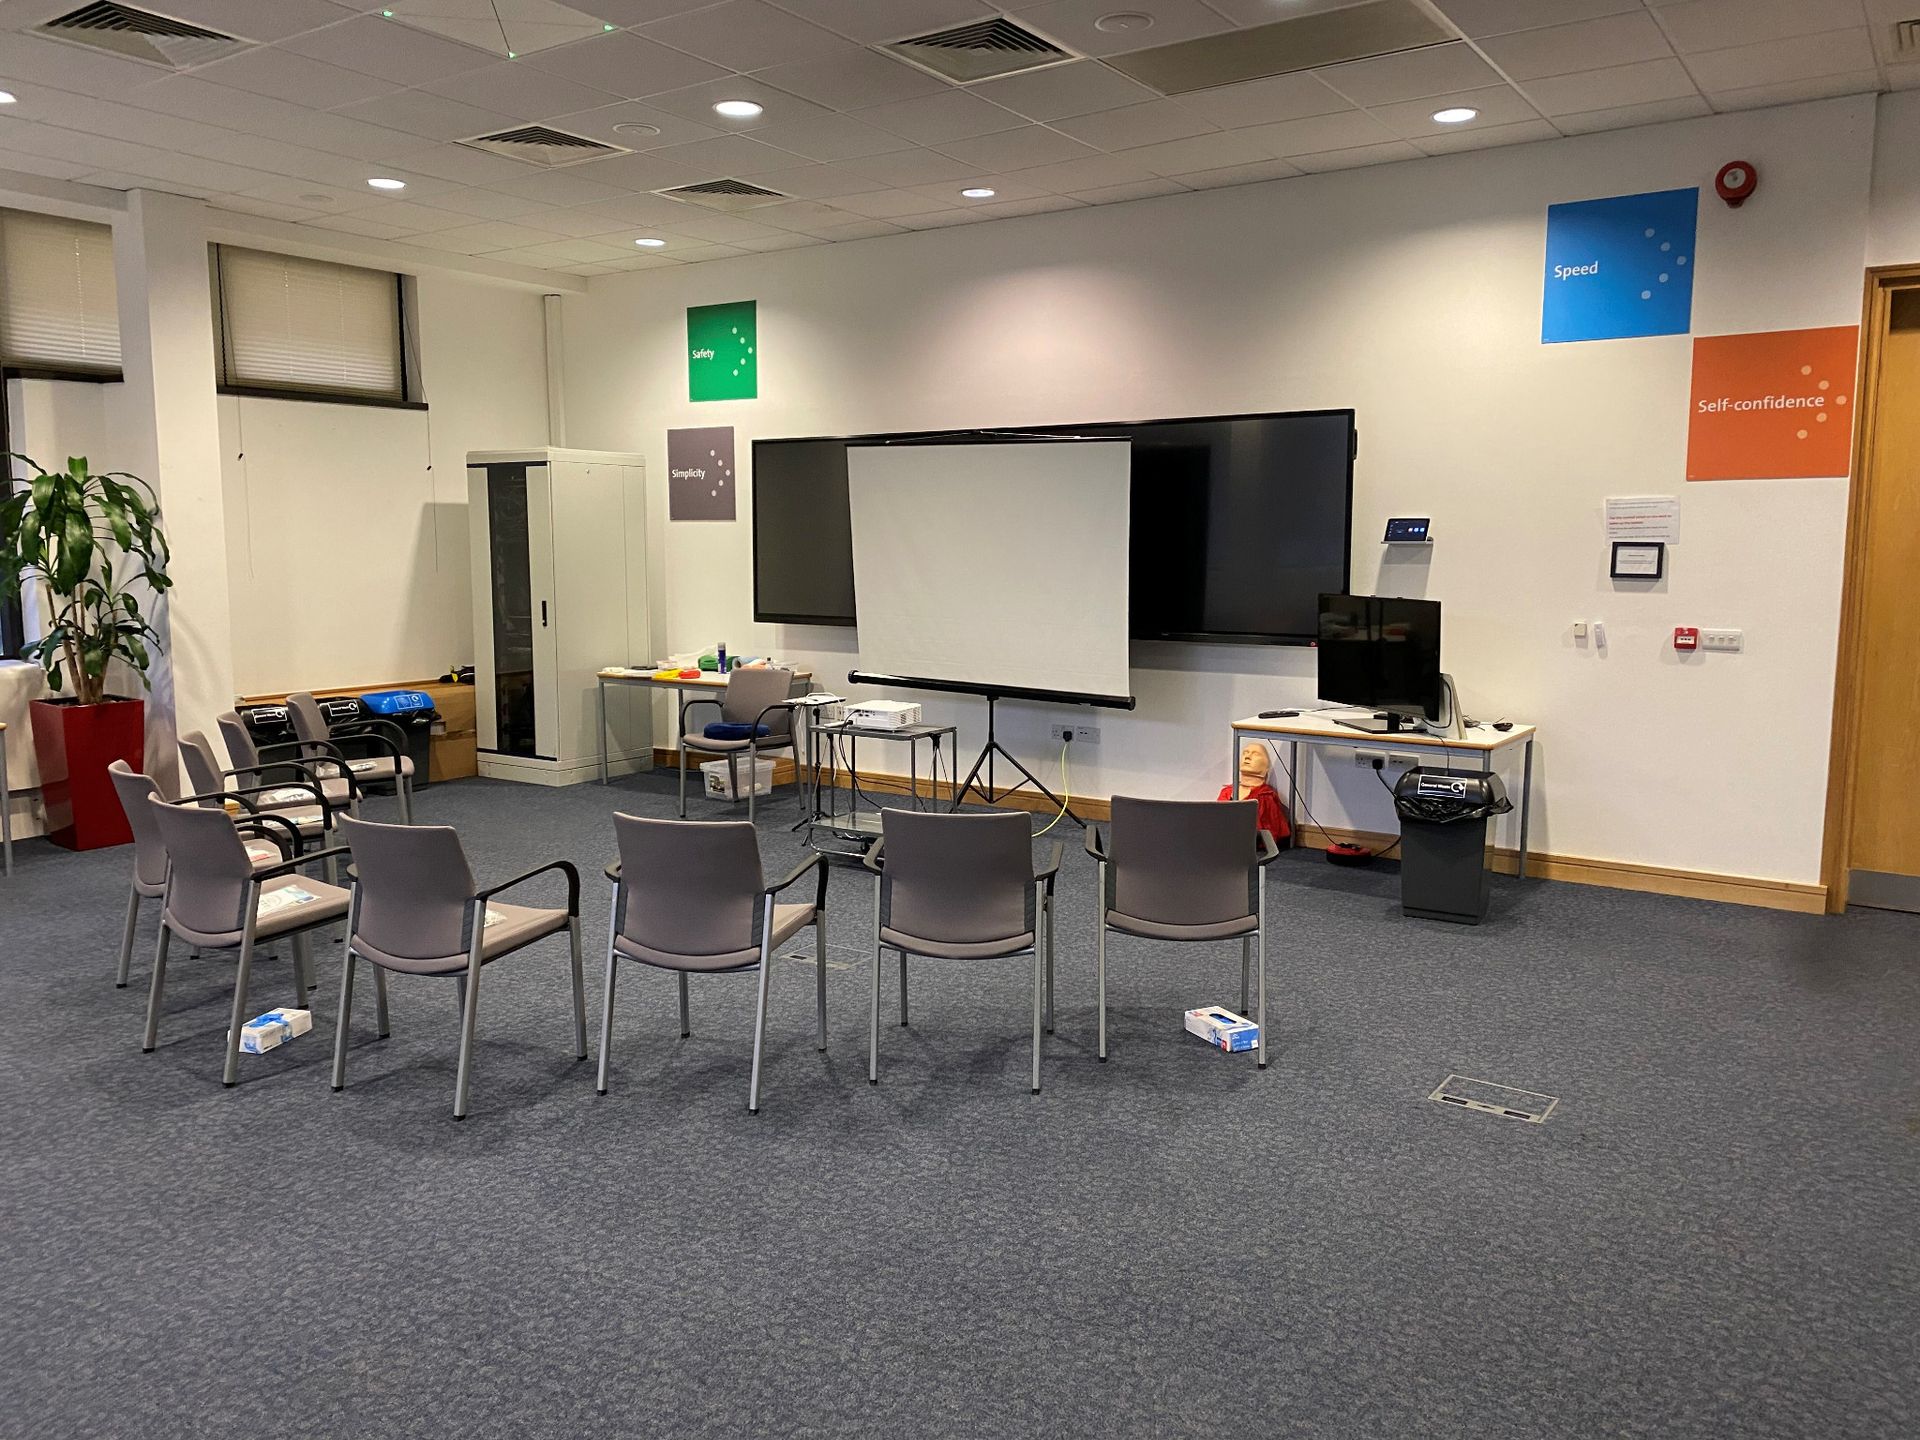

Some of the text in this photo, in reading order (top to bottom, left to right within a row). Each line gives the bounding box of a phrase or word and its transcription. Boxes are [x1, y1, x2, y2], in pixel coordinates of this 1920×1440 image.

[1554, 260, 1598, 281] Speed
[692, 348, 715, 361] Safety
[1698, 395, 1825, 413] Self-confidence
[671, 468, 706, 480] Simplicity
